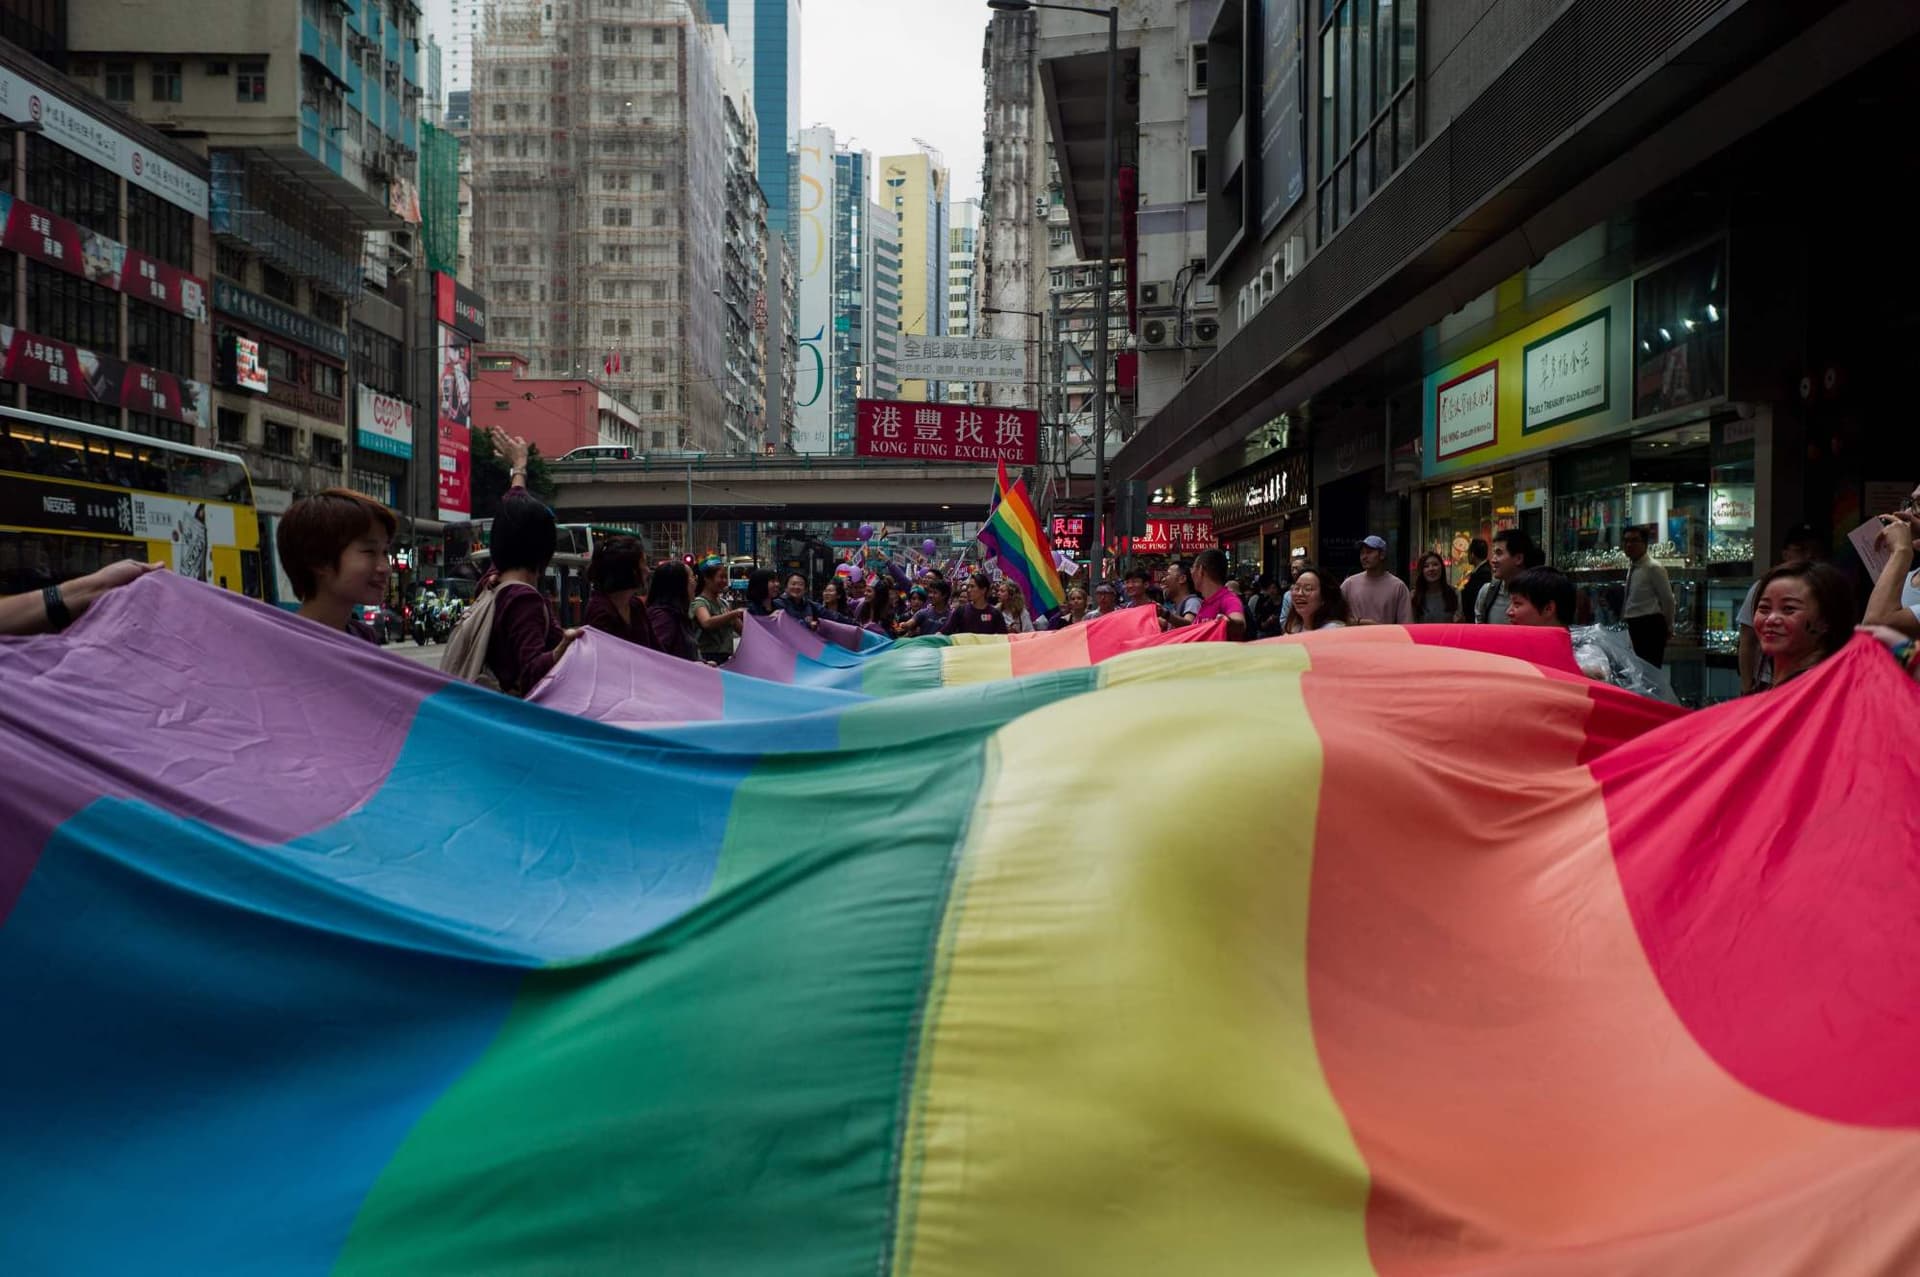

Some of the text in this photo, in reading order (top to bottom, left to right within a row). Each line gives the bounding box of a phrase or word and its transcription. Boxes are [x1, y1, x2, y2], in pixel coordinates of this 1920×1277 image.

[870, 440, 1024, 461] KONG FUNG EXCHANGE
[1132, 523, 1218, 542] 豐人民幣找
